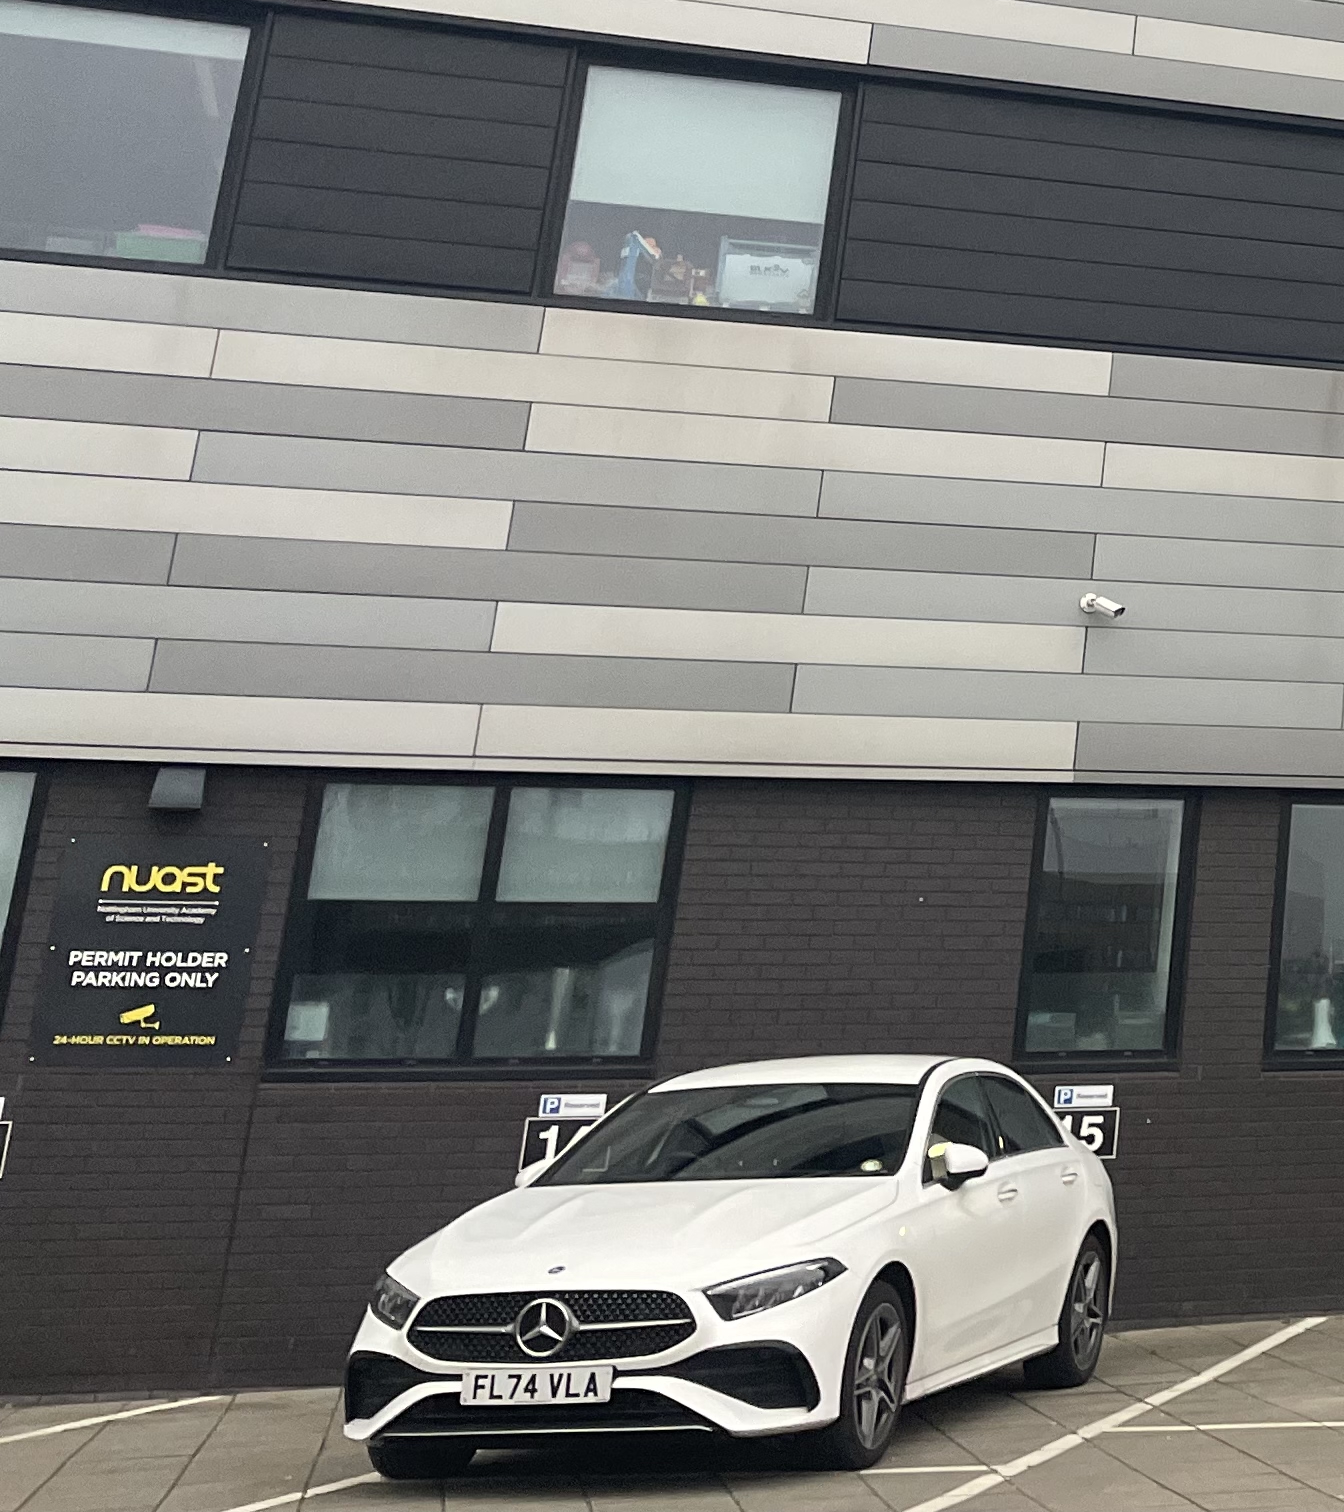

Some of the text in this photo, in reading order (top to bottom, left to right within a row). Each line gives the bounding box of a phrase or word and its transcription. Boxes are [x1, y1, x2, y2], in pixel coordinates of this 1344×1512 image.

[100, 862, 225, 893] nuast
[68, 950, 228, 968] PERMIT HOLDER
[71, 971, 219, 988] PARKING ONLY
[52, 1035, 216, 1046] 24-HOUR CCTV IN OPERATION
[472, 1372, 599, 1400] FL74 VLA
